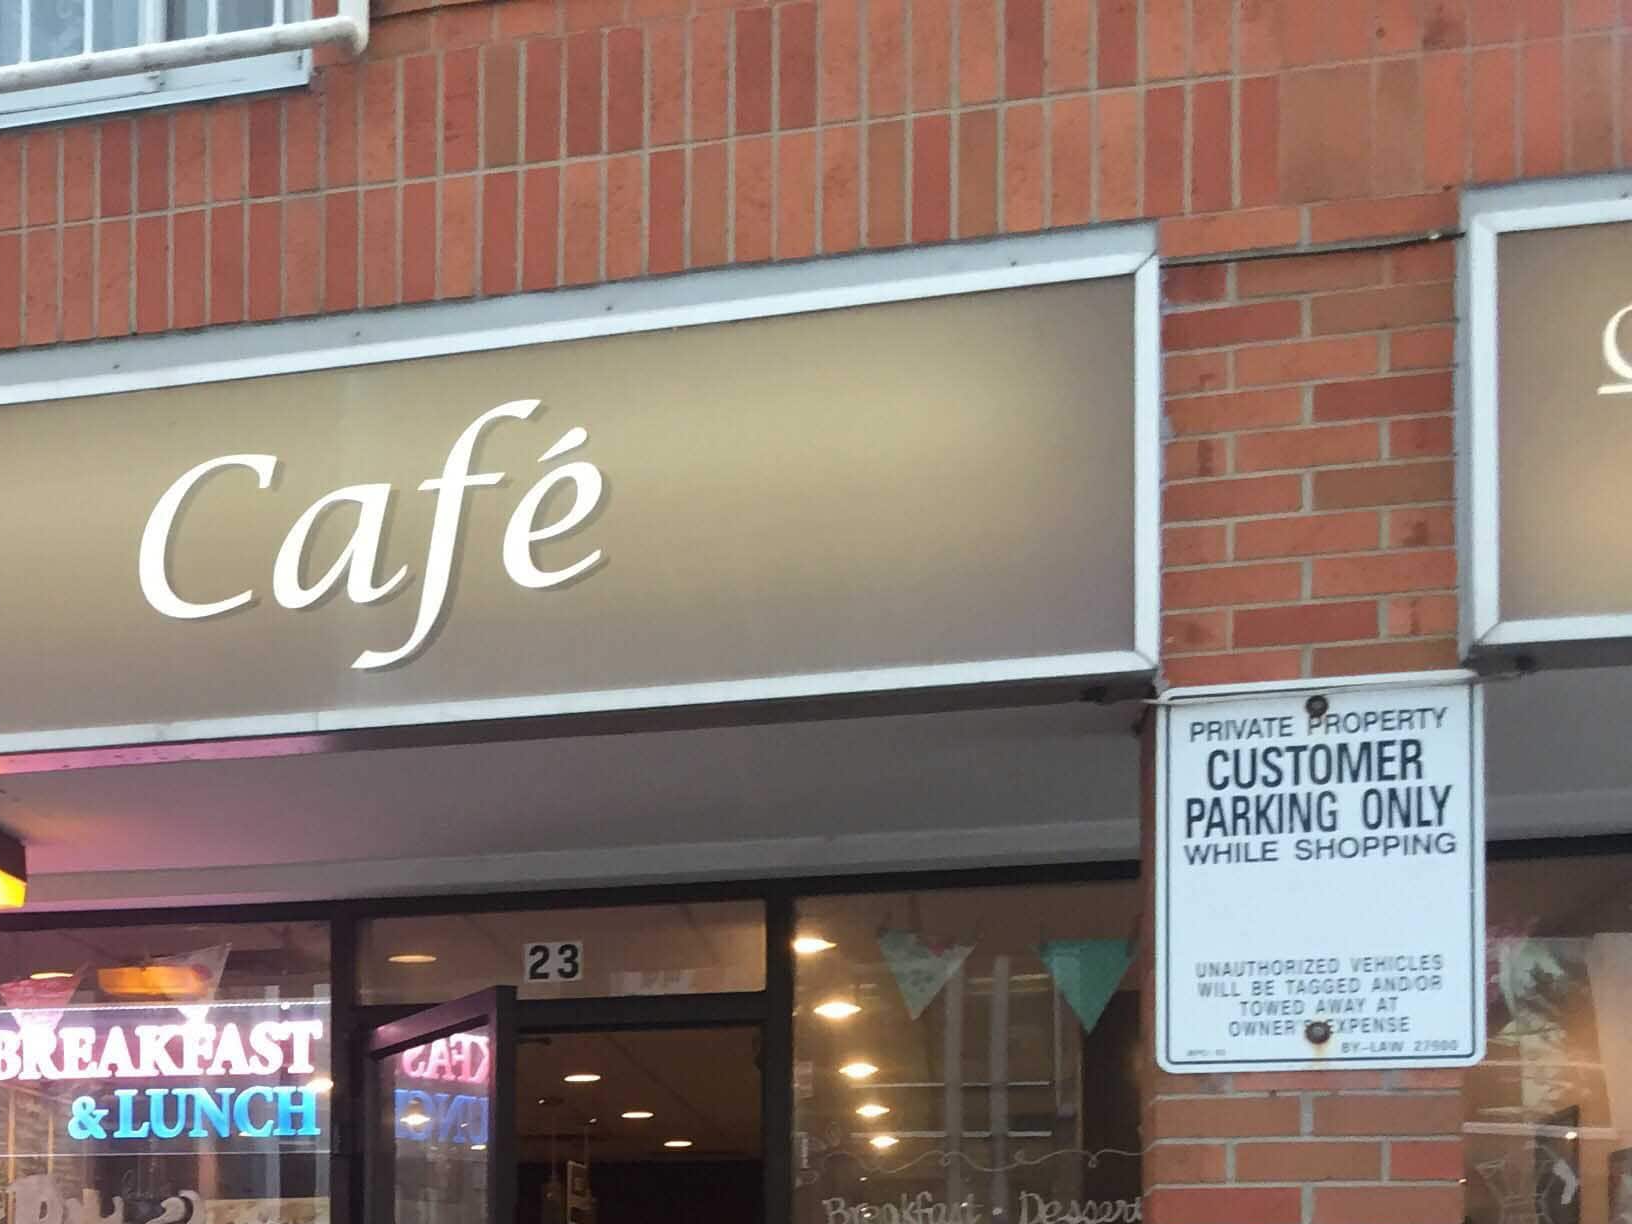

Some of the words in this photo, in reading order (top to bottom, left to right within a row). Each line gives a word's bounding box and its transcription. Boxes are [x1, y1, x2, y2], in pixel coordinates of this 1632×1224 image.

[137, 398, 605, 670] Café
[1189, 715, 1294, 743] PRIVATE
[1307, 706, 1449, 736] PROPERTY
[1206, 738, 1425, 791] CUSTOMER
[1185, 790, 1338, 839] PARKING
[1361, 785, 1453, 831] ONLY
[1184, 842, 1280, 866] WHILE
[1294, 832, 1457, 862] SHOPPING
[527, 943, 581, 981] 23
[1195, 957, 1341, 979] UNAUTHORIZED
[1349, 953, 1443, 974] VEHICLES
[1197, 980, 1241, 998] WILL
[1251, 979, 1275, 996] BE
[1285, 977, 1362, 995] TAGGED
[1240, 1000, 1305, 1017] TOWED
[1315, 998, 1366, 1015] AWAY
[1376, 996, 1399, 1013] AT
